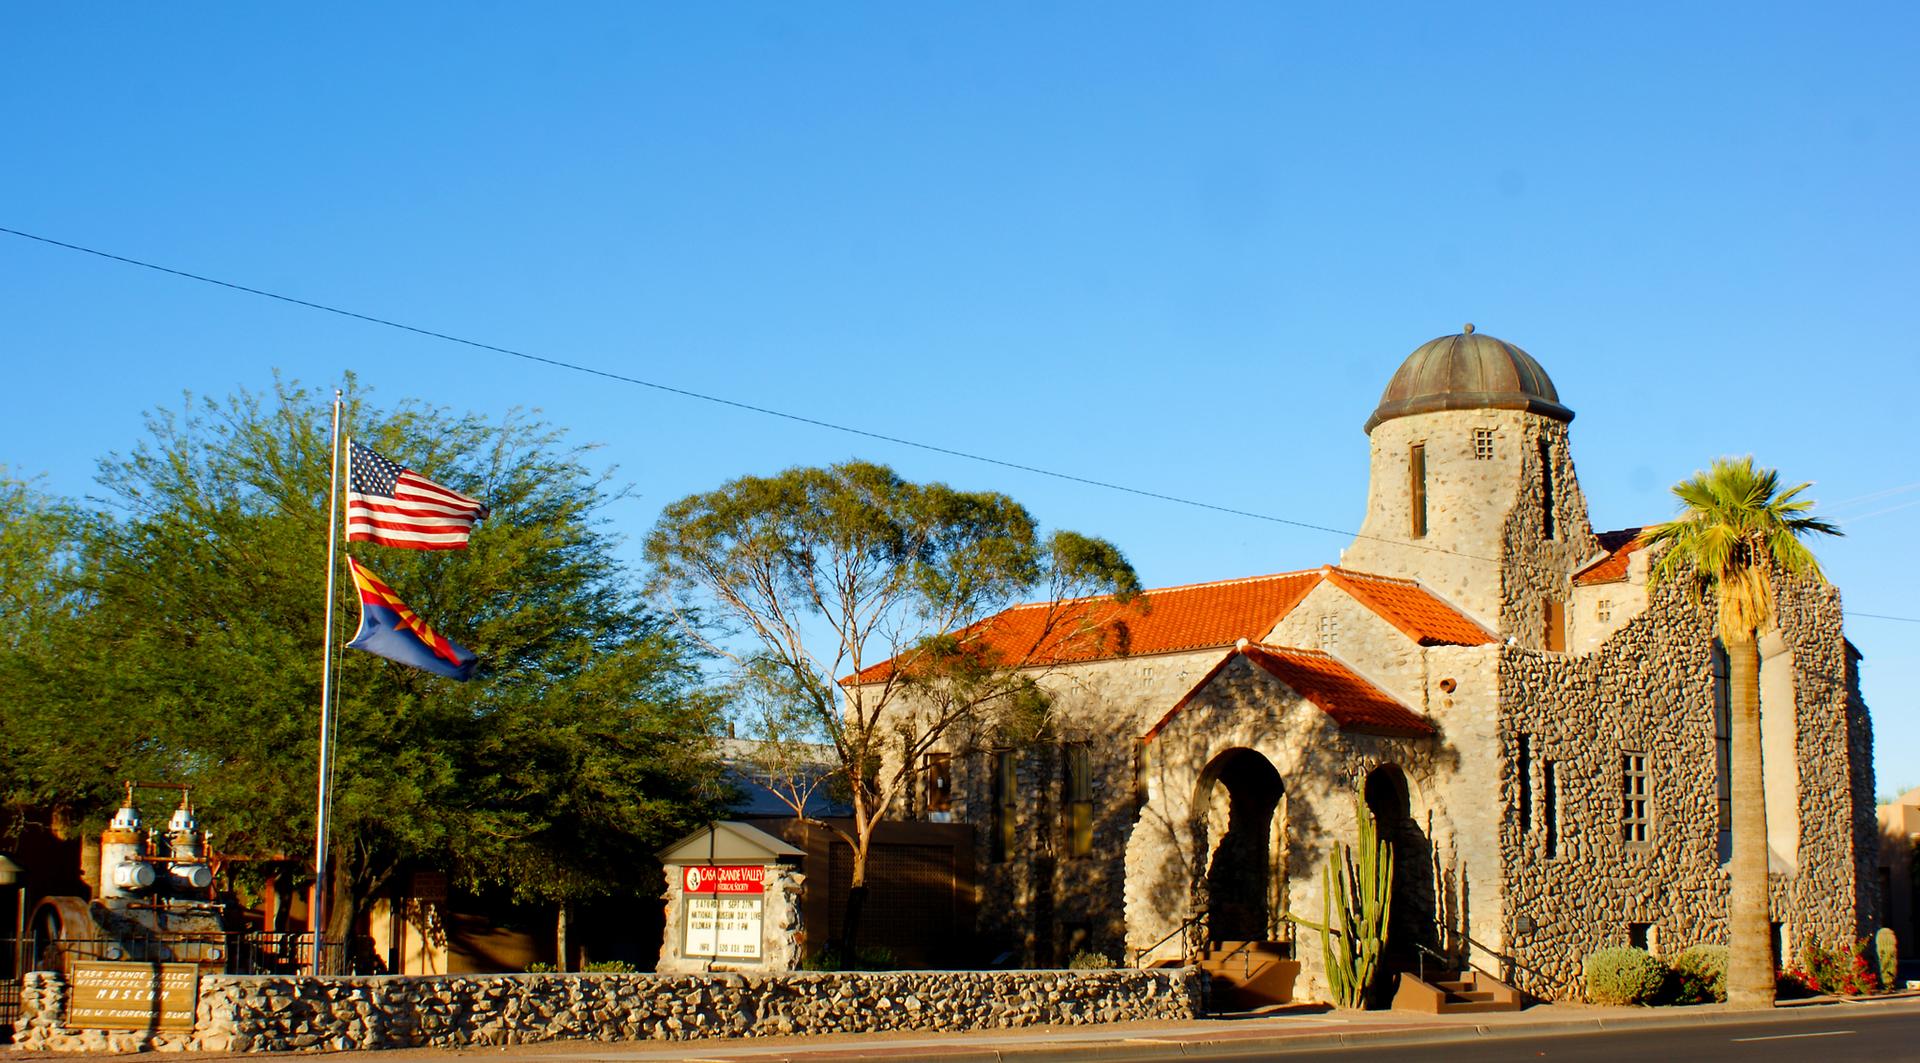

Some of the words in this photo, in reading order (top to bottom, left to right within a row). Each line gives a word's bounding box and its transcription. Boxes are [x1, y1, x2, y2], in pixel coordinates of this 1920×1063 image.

[701, 868, 716, 881] CASA
[717, 868, 740, 882] GRANDE
[741, 868, 764, 881] VALLEY
[735, 882, 748, 891] SOCIETY
[737, 912, 747, 920] DAY
[108, 971, 146, 979] GRANDE
[146, 980, 190, 989] SOCIETY
[96, 989, 170, 1000] MUSEUM
[108, 1009, 159, 1018] FLORENCE
